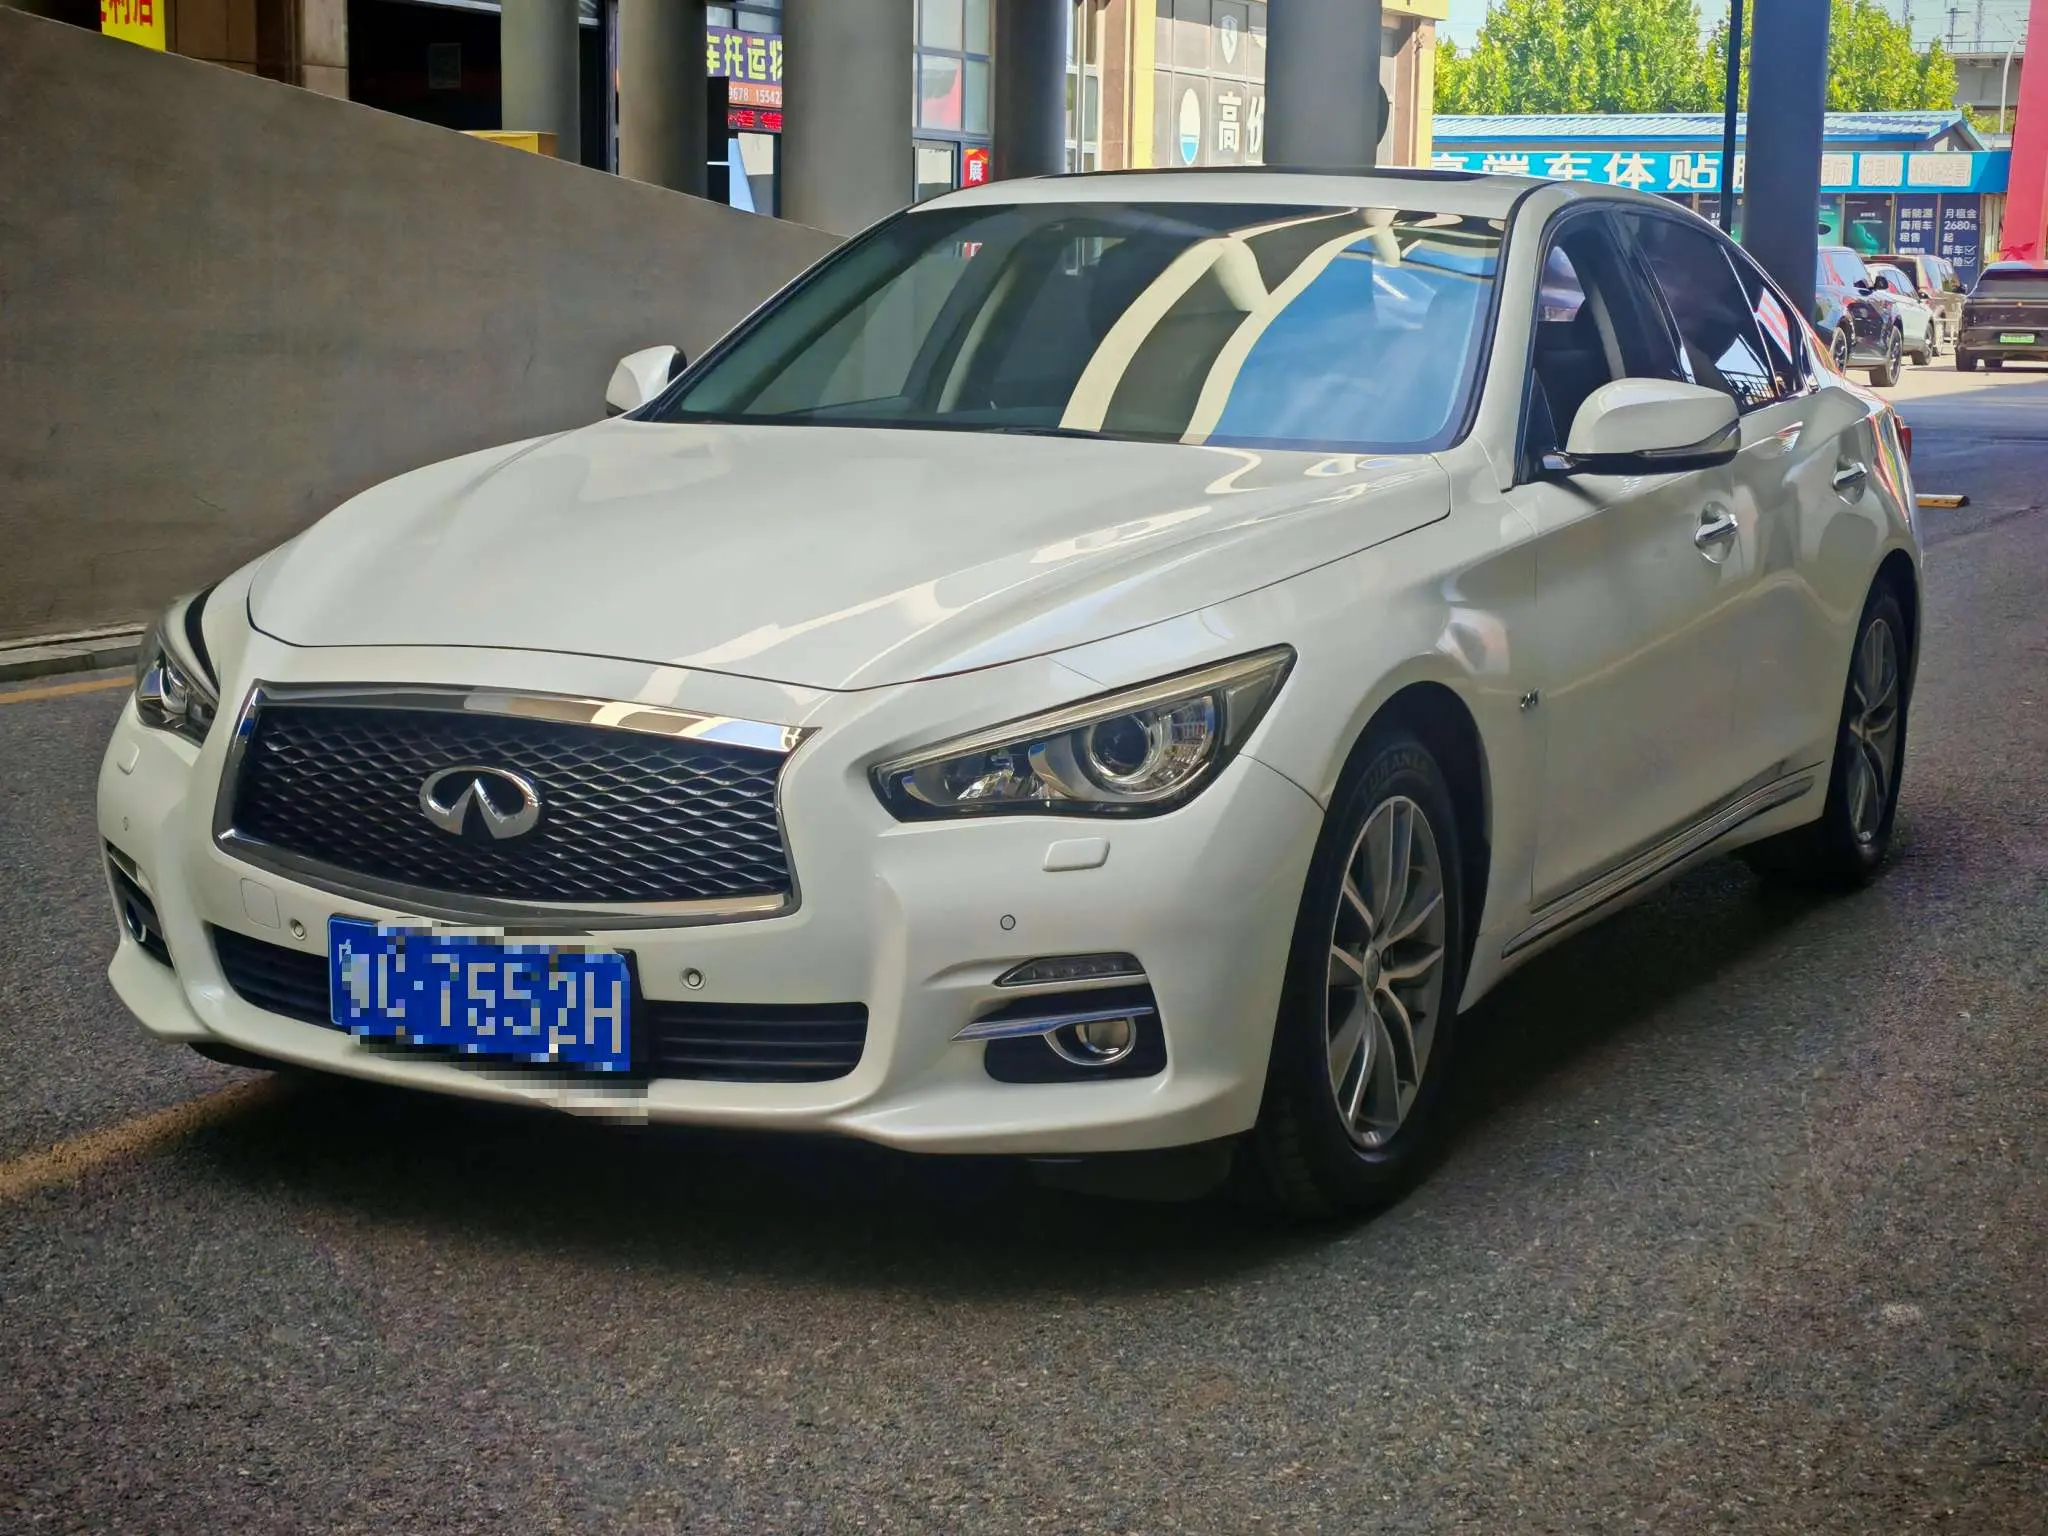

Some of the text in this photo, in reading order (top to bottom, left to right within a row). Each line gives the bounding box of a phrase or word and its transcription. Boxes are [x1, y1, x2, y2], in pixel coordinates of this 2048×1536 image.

[1901, 208, 1933, 219] 新能源
[1944, 208, 1977, 219] 月租金
[1943, 232, 1954, 243] 起
[1942, 245, 1964, 255] 新车
